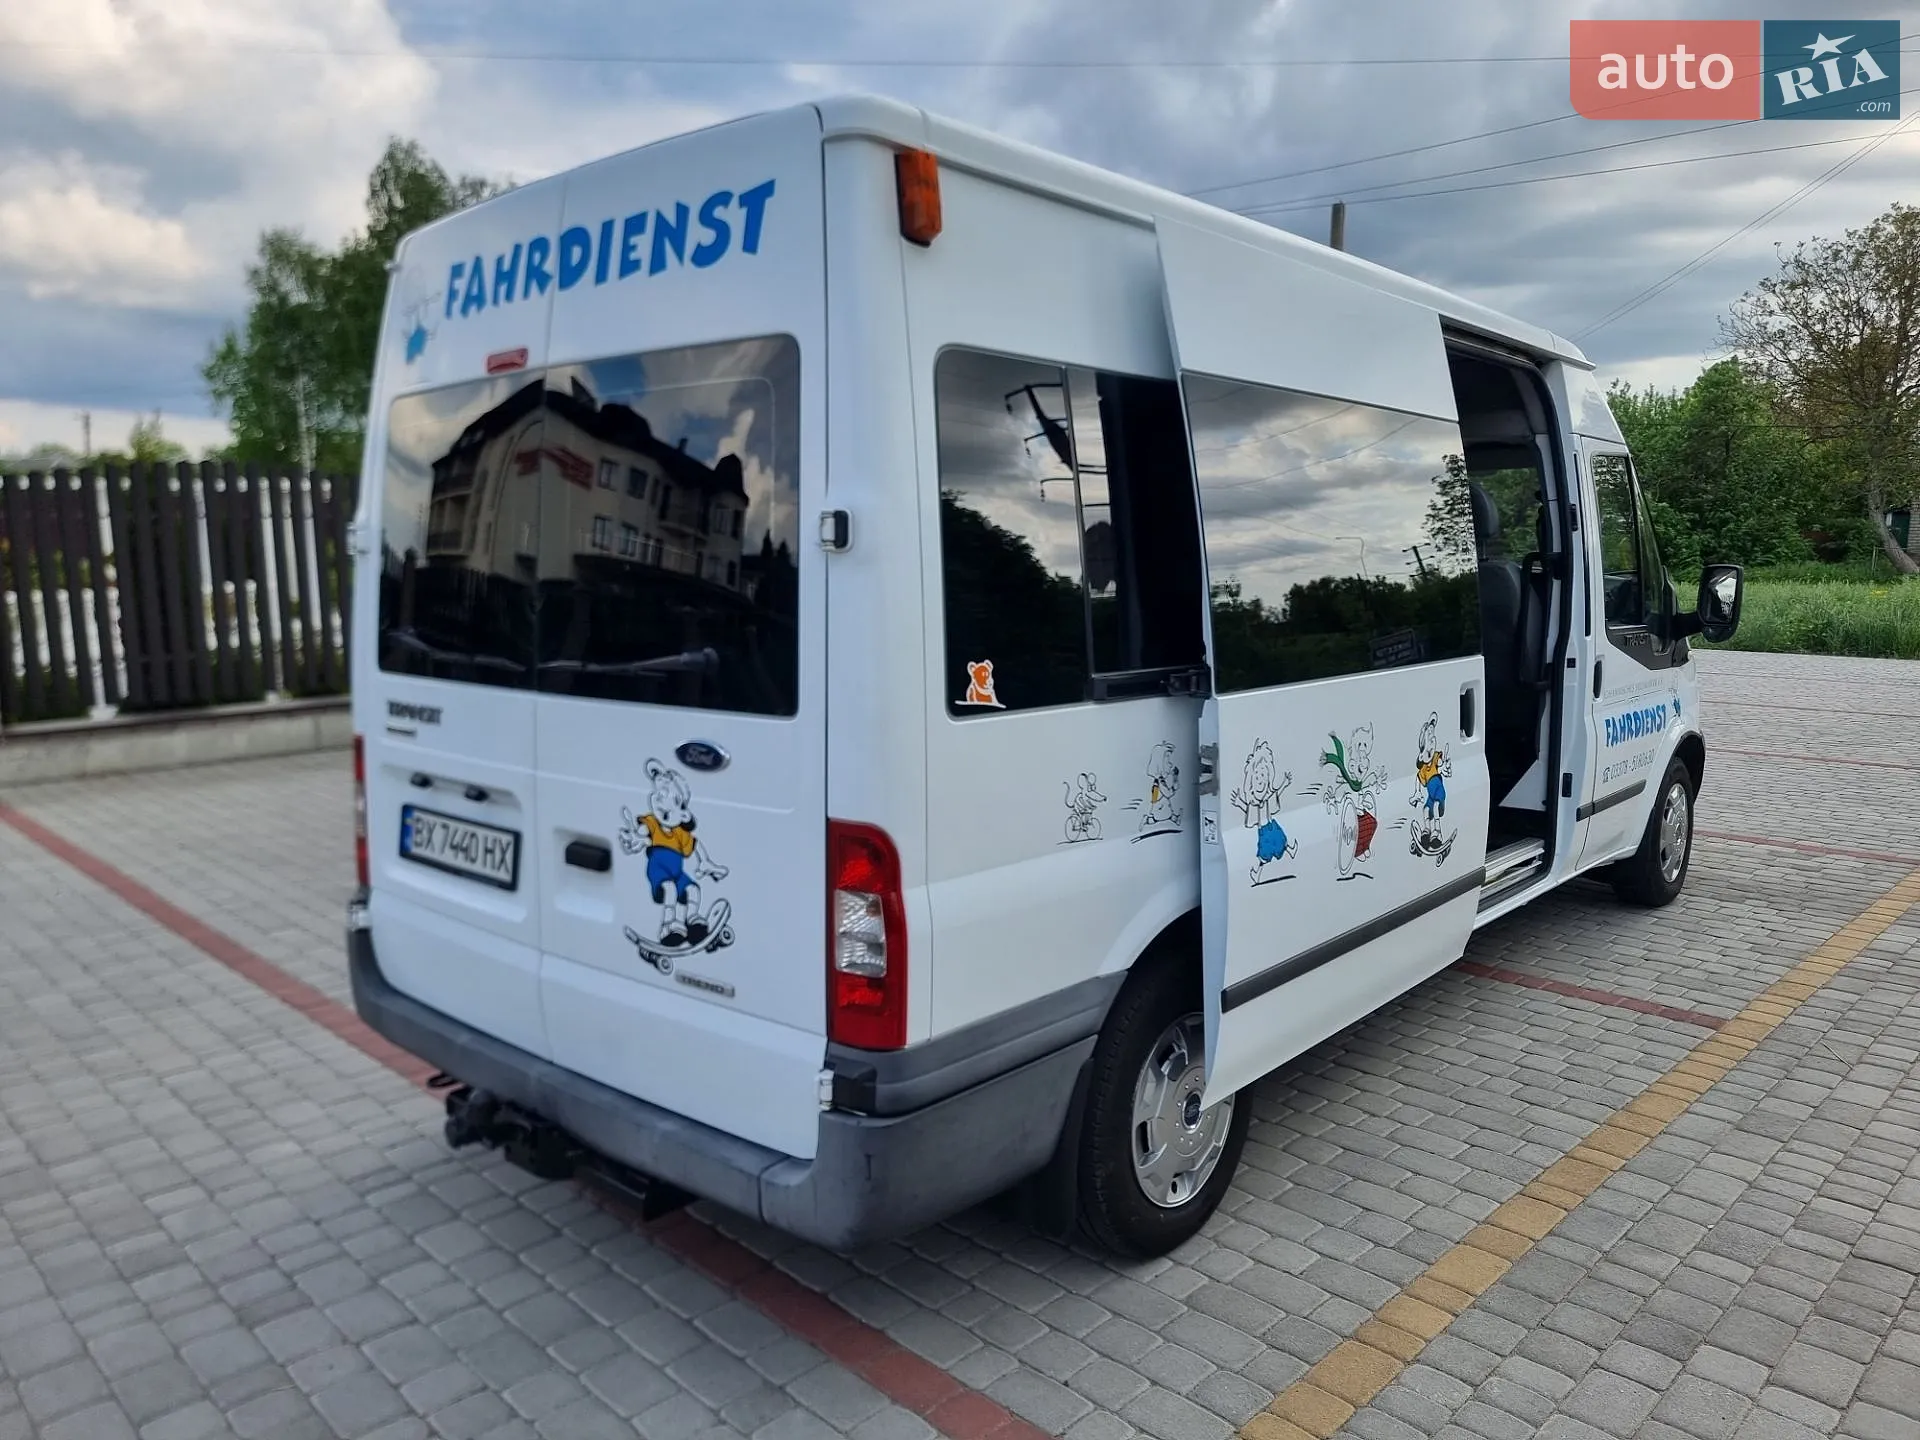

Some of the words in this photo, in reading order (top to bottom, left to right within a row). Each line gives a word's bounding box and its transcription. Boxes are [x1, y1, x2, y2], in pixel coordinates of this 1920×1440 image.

[444, 178, 777, 320] FAHRDIENST
[1604, 704, 1666, 747] FAHRDIENST
[413, 817, 437, 852] BX
[440, 823, 480, 863] 7440
[483, 835, 513, 873] HX
